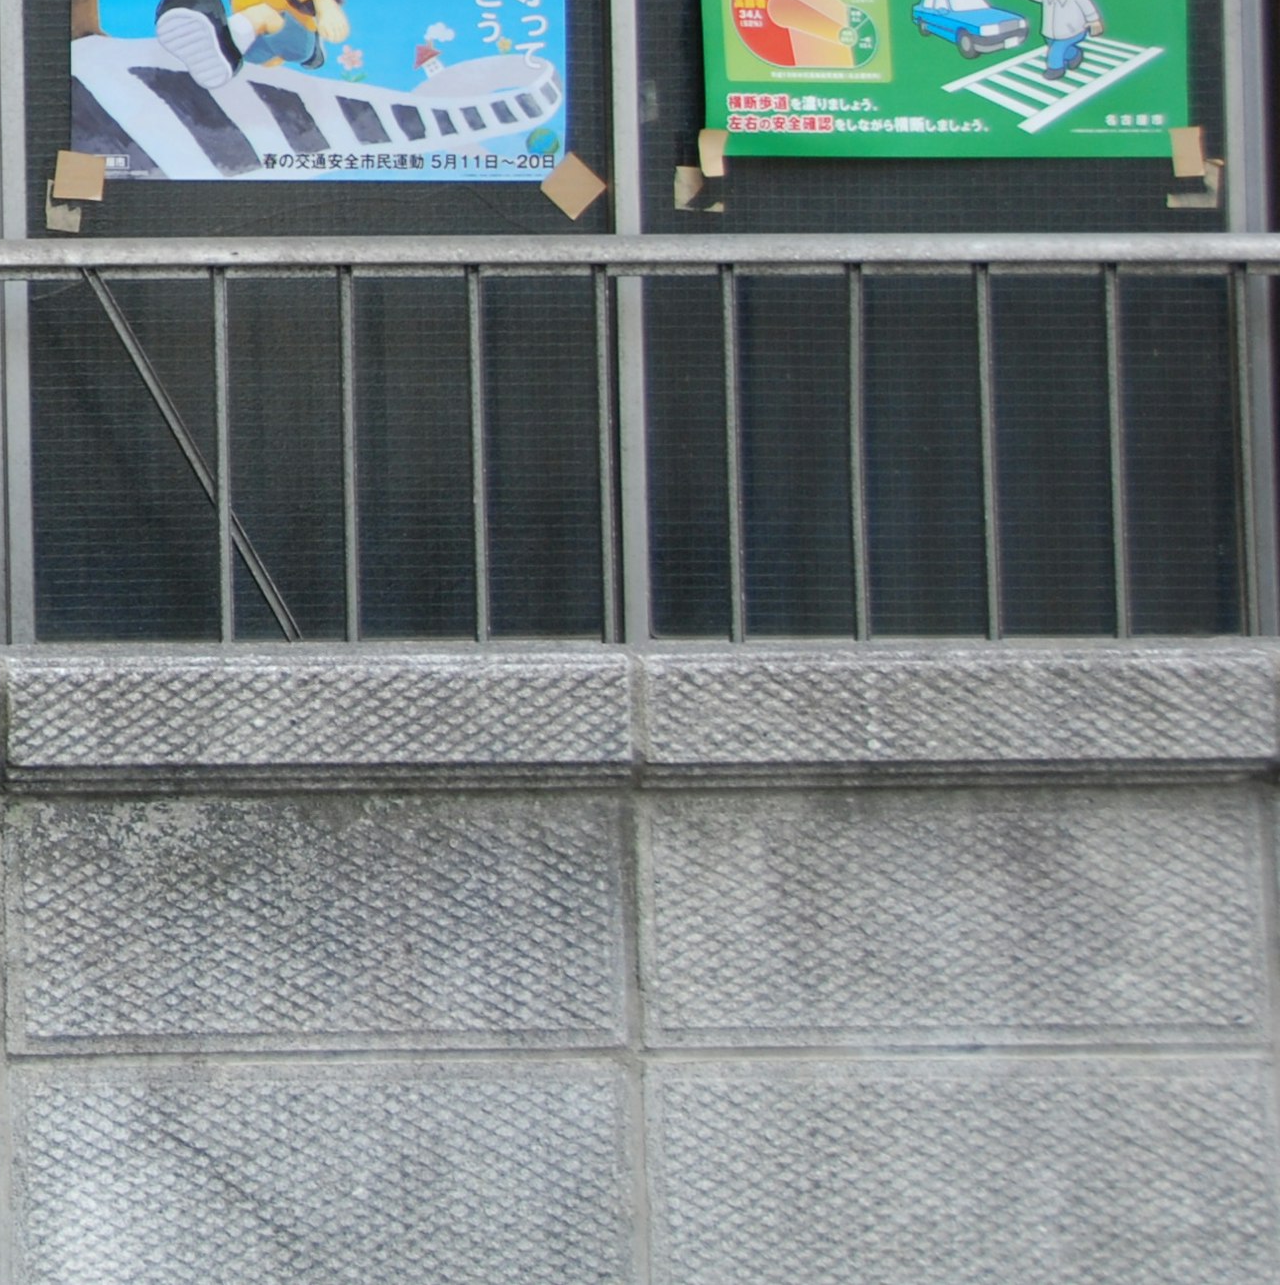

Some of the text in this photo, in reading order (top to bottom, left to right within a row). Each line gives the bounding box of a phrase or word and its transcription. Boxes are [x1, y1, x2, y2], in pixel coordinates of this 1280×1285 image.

[728, 95, 879, 111] 横断歩道を渡りましょう。
[728, 116, 990, 133] 左右の安全確認をしながら横断しましょう。
[263, 154, 424, 171] 春の交通安全市民運動
